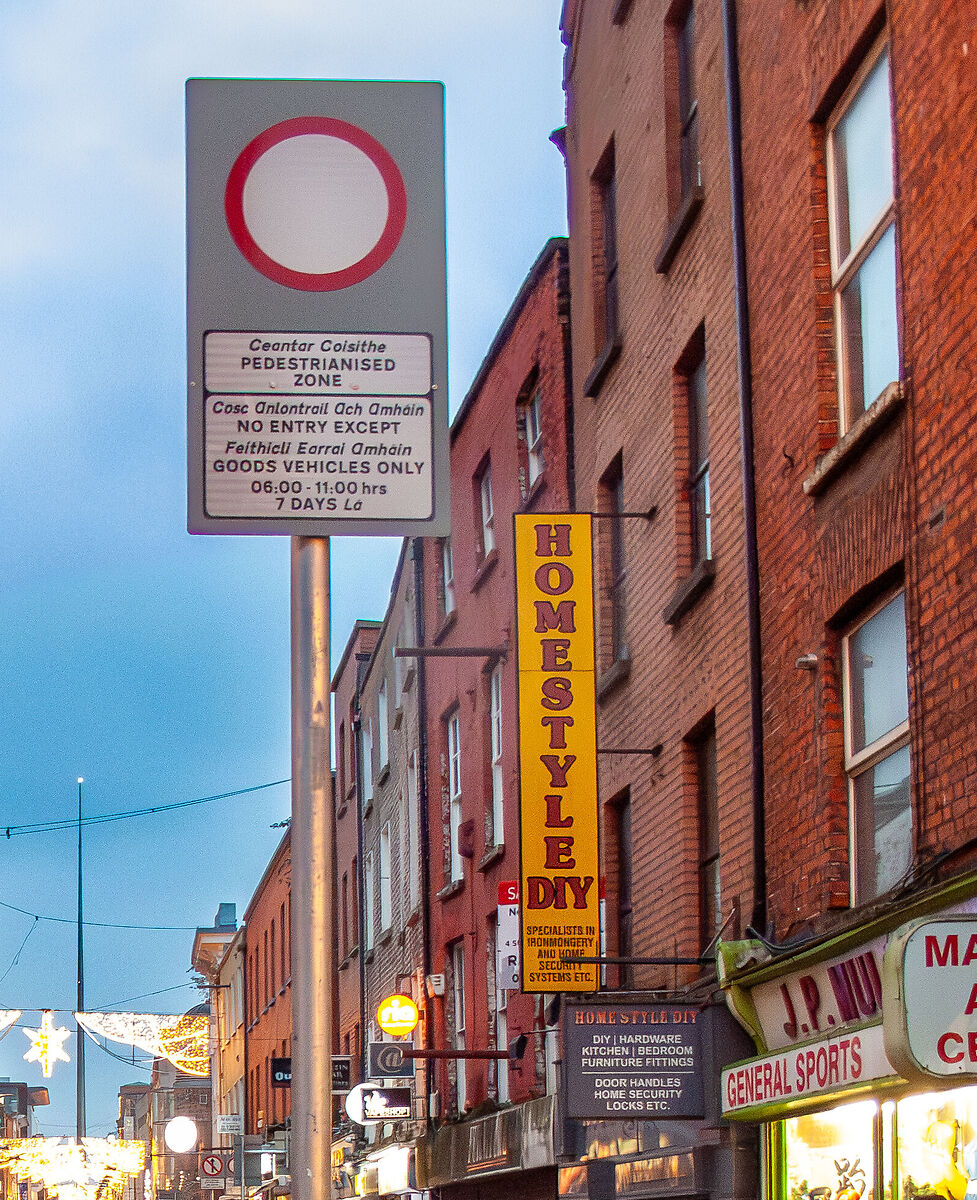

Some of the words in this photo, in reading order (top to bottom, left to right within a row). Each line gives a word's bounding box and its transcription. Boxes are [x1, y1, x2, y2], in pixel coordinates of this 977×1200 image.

[249, 338, 314, 353] Ceantar
[320, 339, 387, 353] Coisithe
[241, 356, 396, 371] PEDESTRIANISED
[293, 373, 342, 387] ZONE
[212, 401, 249, 414] Cosc
[237, 420, 263, 433] NO
[270, 420, 328, 434] ENTRY
[334, 421, 401, 434] EXCEPT
[213, 459, 277, 473] GOODS
[283, 460, 371, 474] VEHICLES
[377, 461, 425, 475] ONLY
[250, 480, 302, 494] 06:00
[315, 481, 358, 495] 11:00
[362, 481, 387, 495] hrs
[275, 497, 285, 511] 7
[291, 497, 338, 511] DAYS
[533, 524, 577, 869] HOMESTYLE
[526, 876, 594, 910] DIY
[526, 925, 583, 936] SPECIALISTS
[586, 925, 595, 936] IN
[527, 937, 594, 949] IRONMONGERY
[529, 972, 572, 983] SYSTEMS
[575, 1011, 616, 1025] HOME
[620, 1010, 668, 1025] STYLE
[673, 1010, 698, 1024] DIY
[592, 1034, 611, 1044] DIY
[619, 1034, 682, 1044] HARDWARE
[581, 1046, 629, 1056] KITCHEN
[637, 1046, 693, 1056] BEDROOM
[377, 1045, 405, 1073] @
[581, 1058, 643, 1067] FURNITURE
[645, 1057, 694, 1067] FITTINGS
[727, 1058, 792, 1108] GENERAL
[795, 1036, 863, 1093] SPORTS
[595, 1078, 627, 1088] DOOR
[629, 1078, 681, 1088] HANDLES
[594, 1090, 626, 1099] HOME
[628, 1090, 682, 1099] SECURITY
[606, 1101, 644, 1111] LOCKS
[646, 1101, 671, 1111] ETC.
